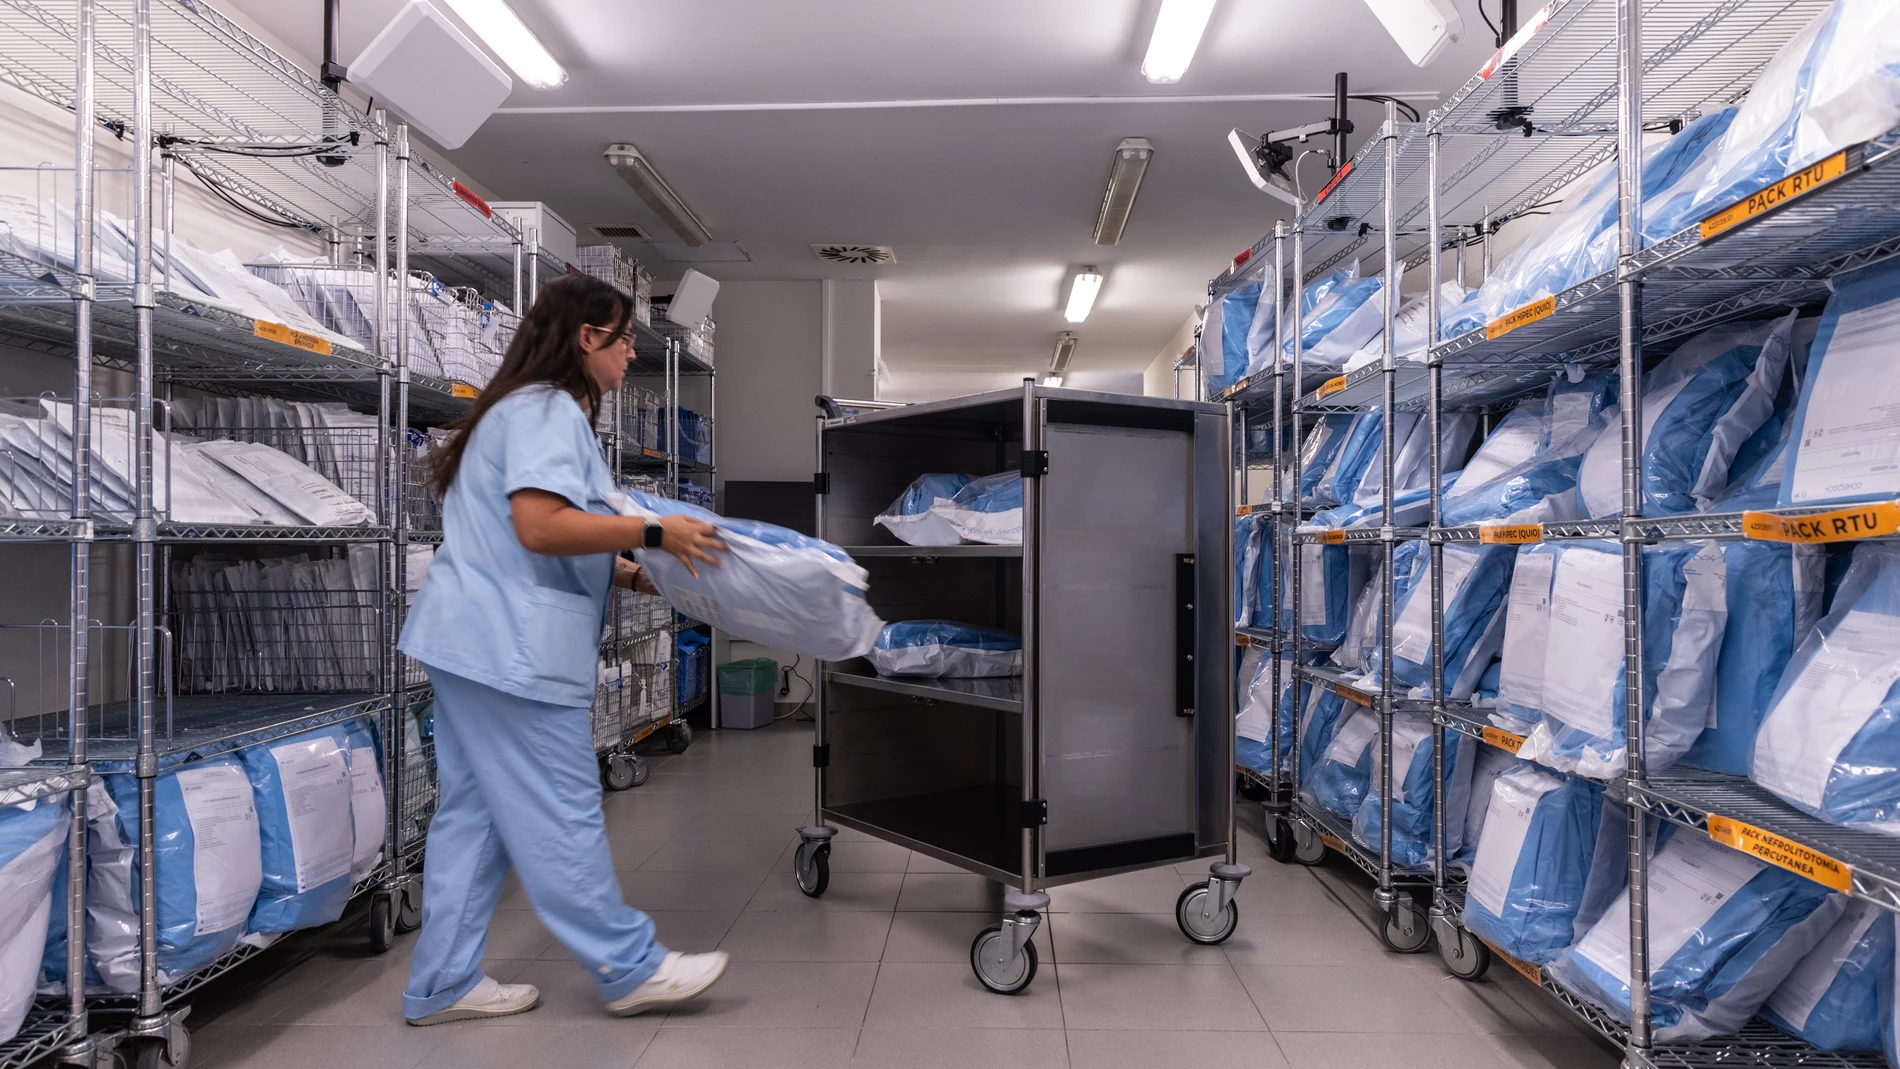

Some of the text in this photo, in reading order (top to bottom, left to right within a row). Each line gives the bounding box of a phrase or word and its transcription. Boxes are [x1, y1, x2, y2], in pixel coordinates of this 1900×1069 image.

[1748, 164, 1825, 214] PACK RTU
[1516, 308, 1534, 321] HIPEC
[1533, 300, 1552, 317] (QUIO)
[1518, 529, 1540, 540] (QUIO)
[1781, 512, 1878, 539] PACK RTU
[1501, 736, 1516, 749] PACK
[1741, 826, 1840, 875] PACK NEFROLITOTOMÍA
[1752, 843, 1815, 876] PERCUTANEA
